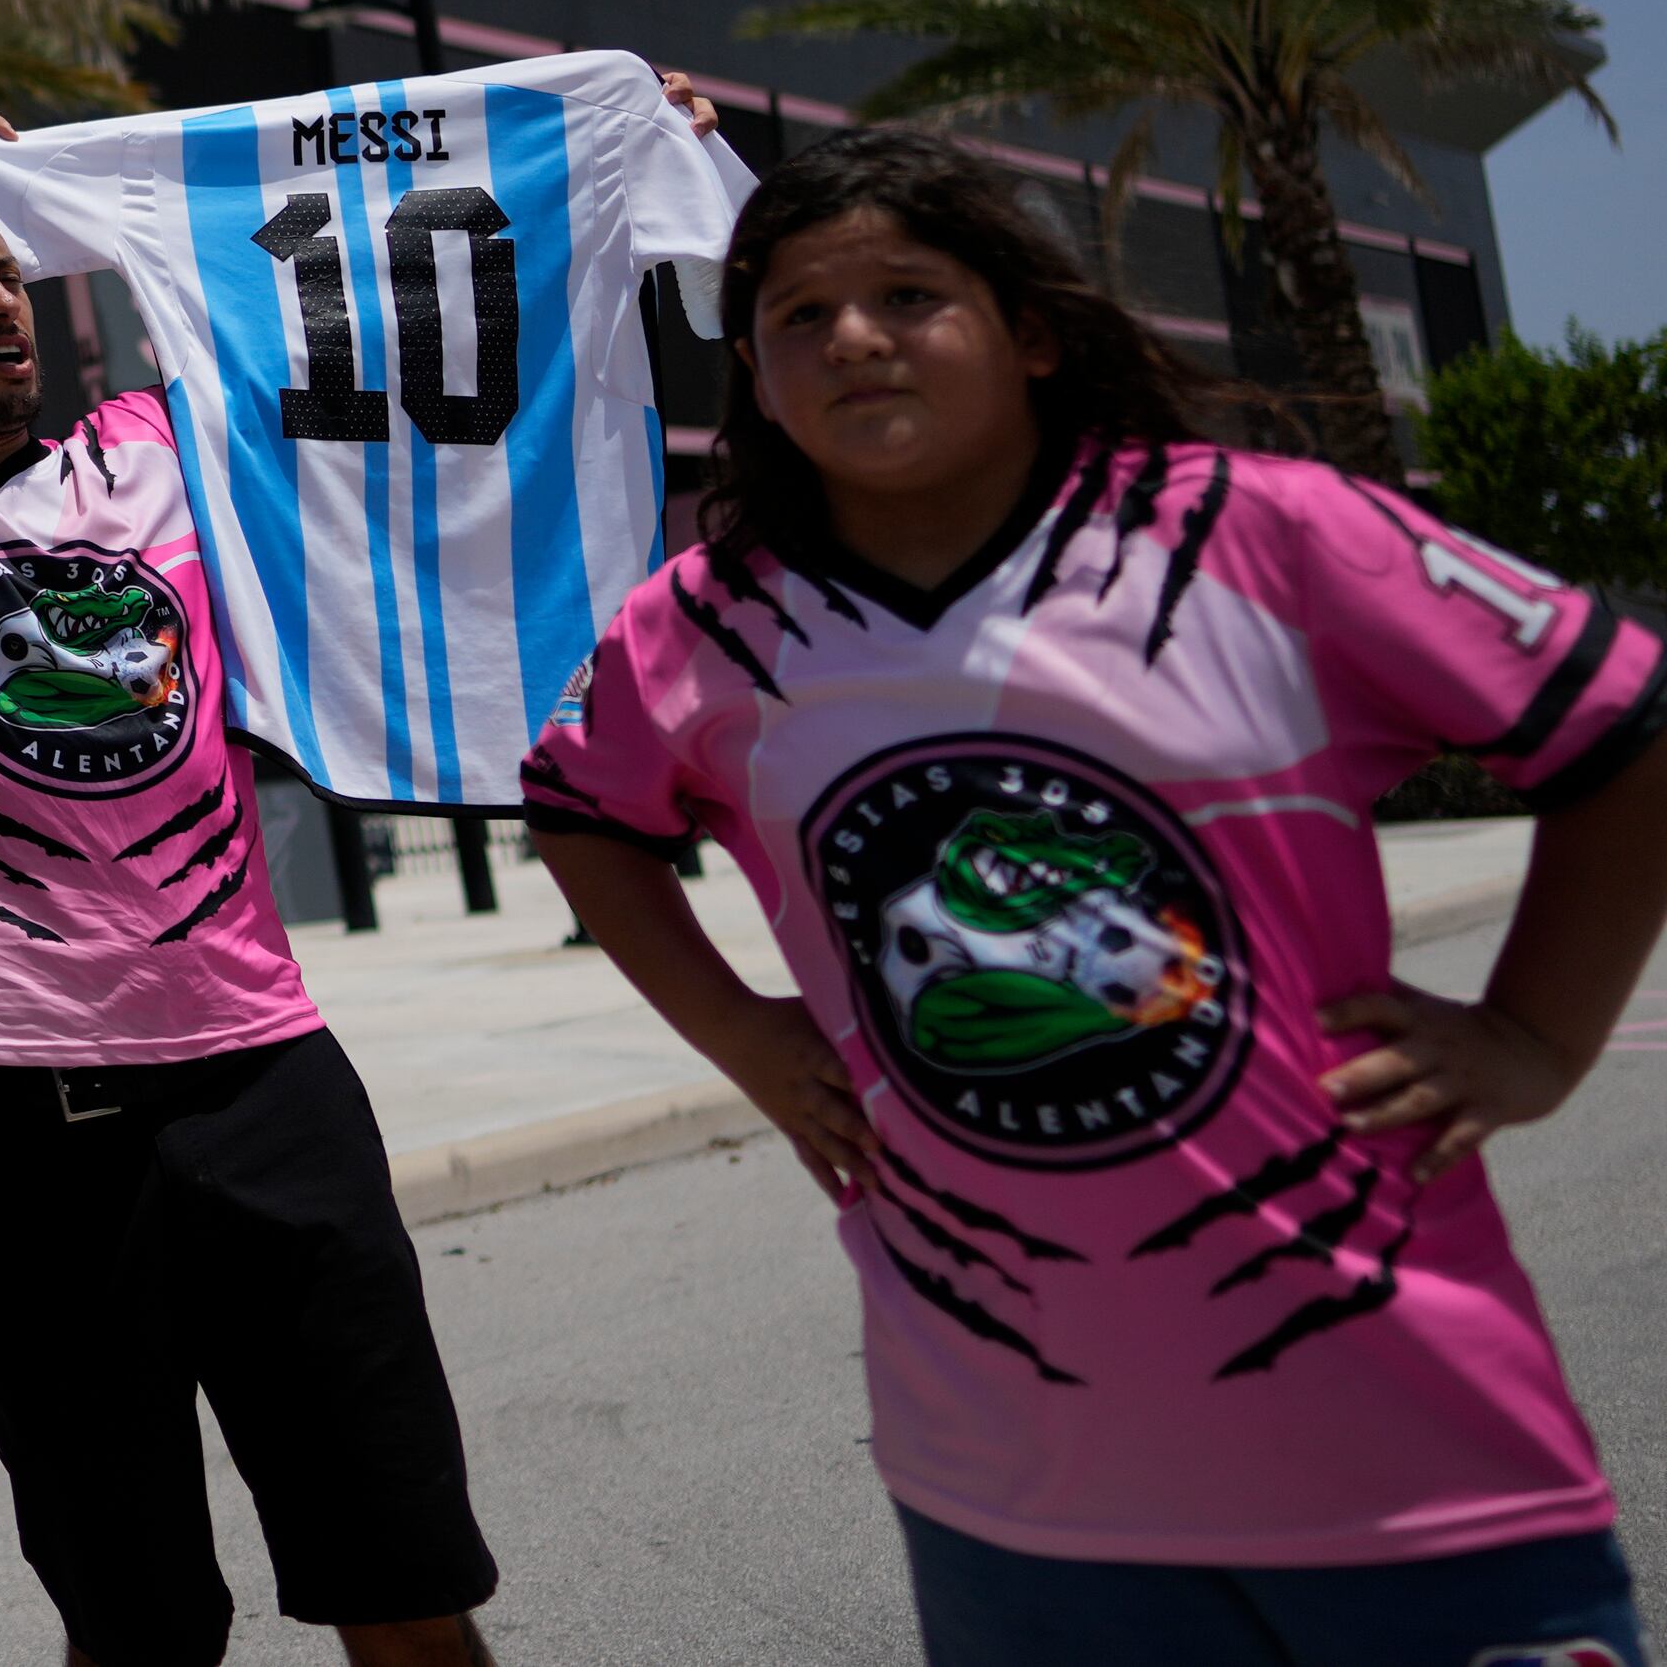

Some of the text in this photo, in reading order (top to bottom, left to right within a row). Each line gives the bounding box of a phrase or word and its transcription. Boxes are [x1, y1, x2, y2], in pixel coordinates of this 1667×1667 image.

[291, 109, 450, 166] MESSI
[250, 186, 519, 446] 10
[67, 562, 128, 584] 305
[156, 606, 171, 618] TM
[21, 662, 186, 774] ALENTANDO
[998, 765, 1114, 824] 305
[956, 956, 1225, 1135] ALENTANDO
